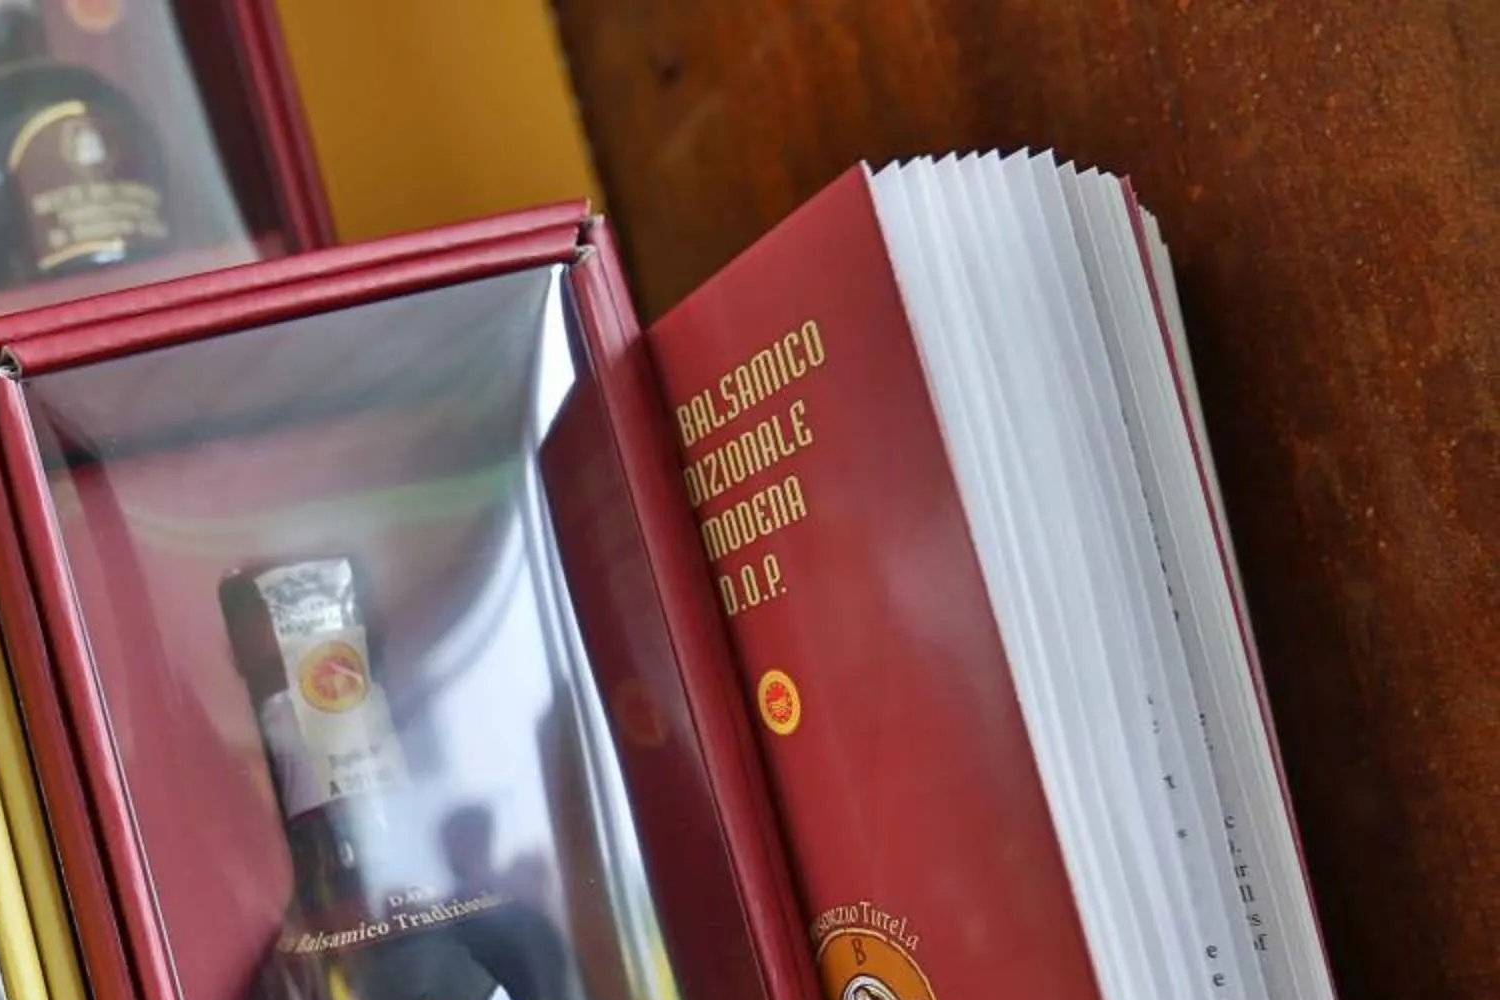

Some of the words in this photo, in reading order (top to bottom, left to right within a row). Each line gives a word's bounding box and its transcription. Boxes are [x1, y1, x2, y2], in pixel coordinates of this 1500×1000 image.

[675, 319, 827, 449] BALSAMICO
[700, 474, 808, 563] MODENA
[718, 553, 788, 617] D.O.P.
